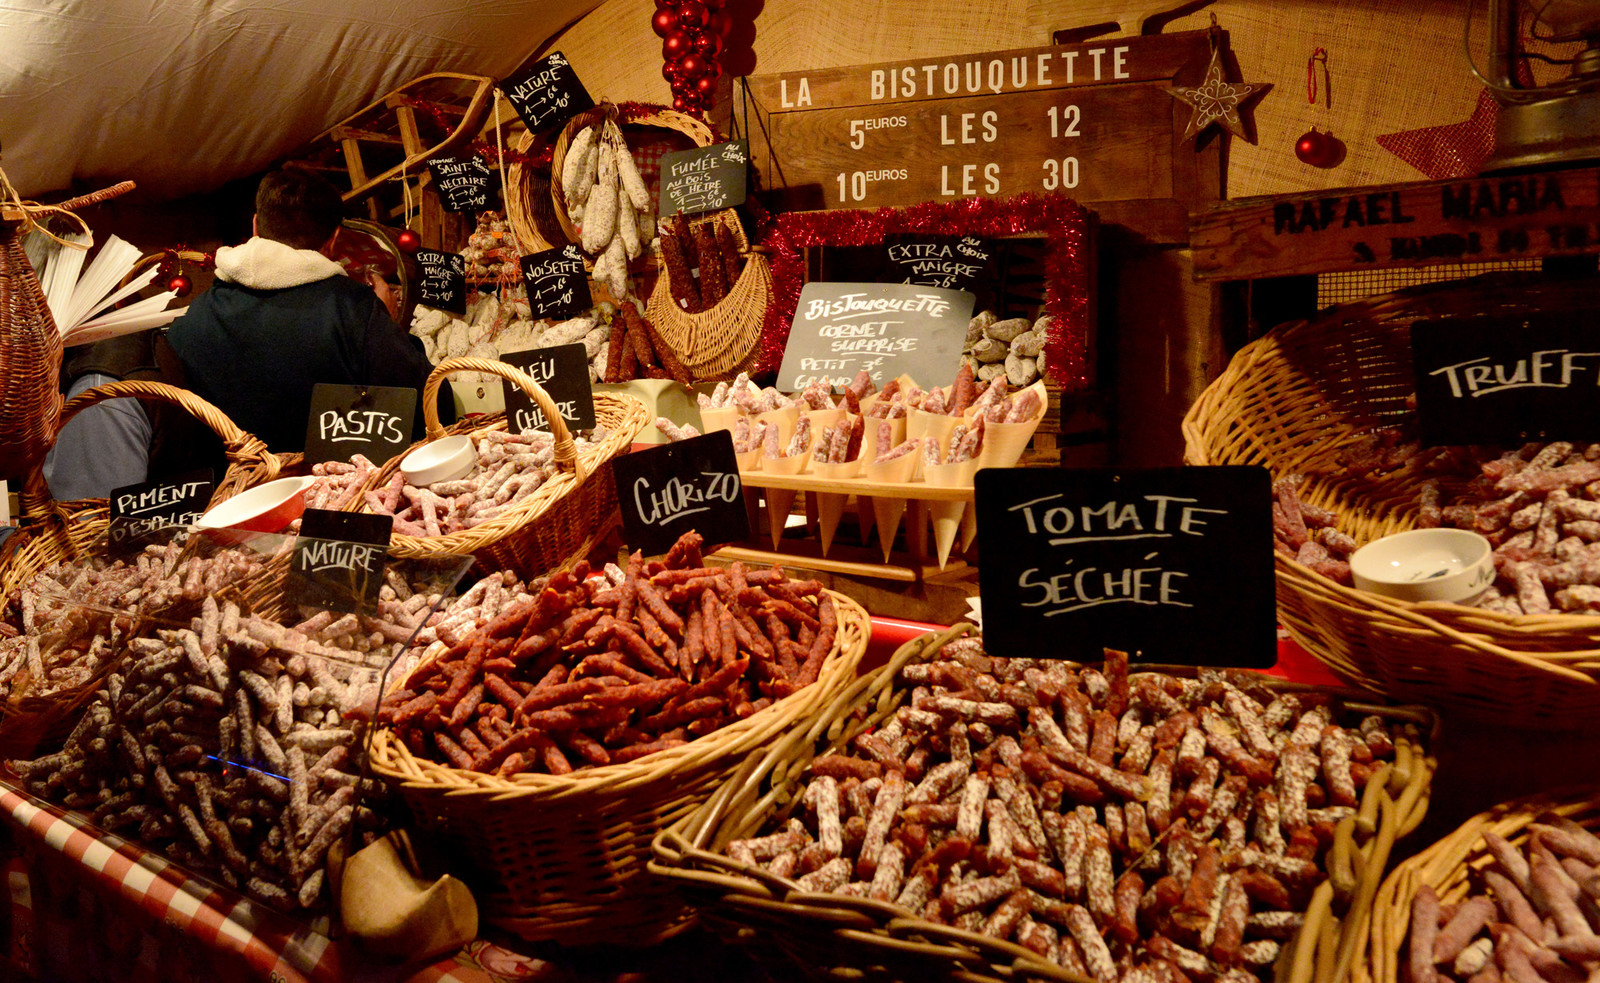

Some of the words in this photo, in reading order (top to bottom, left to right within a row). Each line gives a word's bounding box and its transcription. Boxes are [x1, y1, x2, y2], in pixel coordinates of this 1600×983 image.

[510, 65, 561, 104] NATURE
[781, 77, 812, 109] LA
[871, 46, 1130, 101] BISTOUQUETTE
[940, 111, 998, 147] LES
[1047, 105, 1081, 139] 12
[671, 153, 720, 176] FUMÉE
[721, 151, 746, 164] CHOIX
[439, 174, 488, 191] NECTAIRE
[666, 179, 682, 190] AU
[685, 172, 711, 185] BOIS
[941, 162, 1001, 197] LES
[1043, 156, 1079, 191] 30
[670, 189, 682, 199] DE
[1273, 190, 1415, 236] RAFAEL
[1441, 176, 1567, 221] MARIA
[566, 244, 576, 252] AU
[888, 243, 953, 261] EXTRA
[956, 243, 989, 261] CHOIX
[961, 236, 981, 246] AU
[416, 251, 446, 265] EXTRA
[424, 266, 455, 281] MAIGRE
[525, 259, 582, 281] NOISETTE
[912, 261, 983, 278] MAIGRE
[804, 292, 951, 321] BISTOUQUETTE
[818, 320, 905, 338] CORNET
[831, 337, 919, 352] SURPRISE
[800, 357, 857, 372] PETIT
[1429, 349, 1600, 398] TRUFF
[319, 410, 404, 443] PASTIS
[117, 481, 211, 514] PIMENT
[633, 471, 740, 525] CHORIZO
[1007, 493, 1229, 536] TOMATE
[302, 539, 384, 572] NATURE
[1018, 551, 1194, 607] SÉCHÉE
